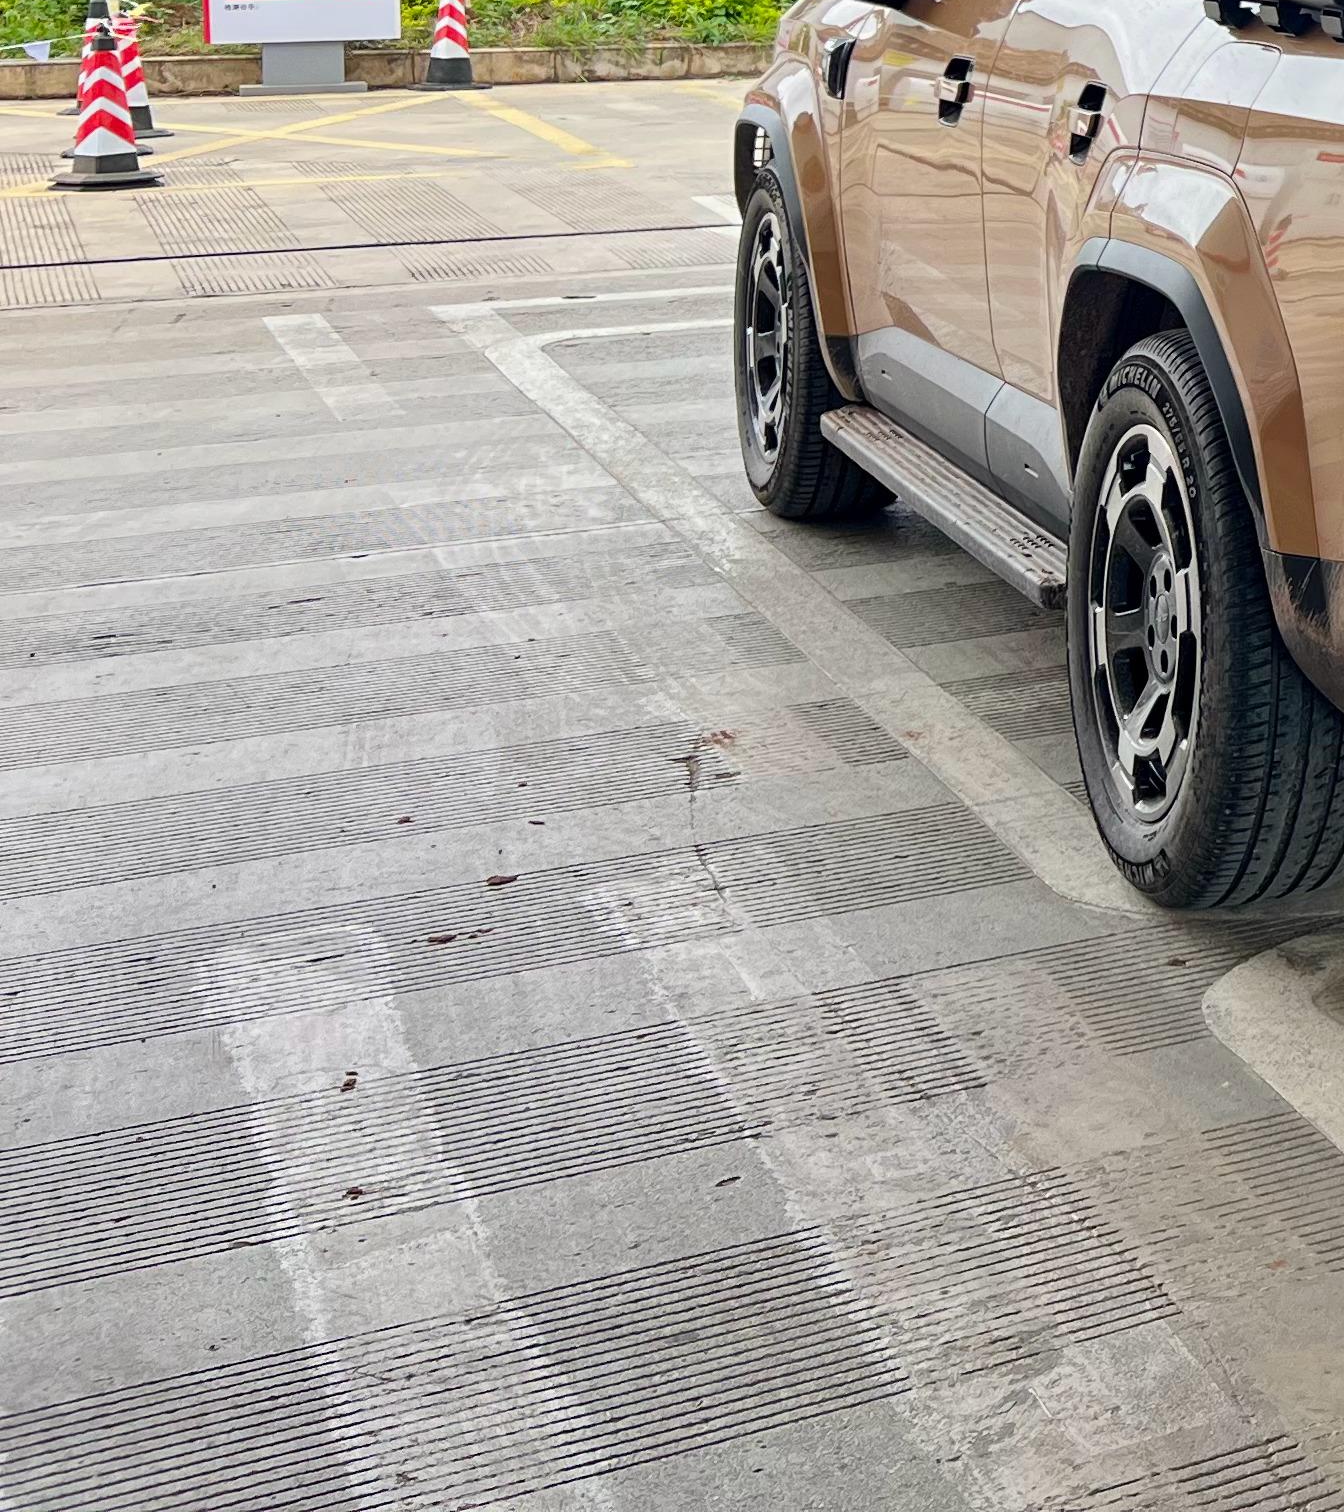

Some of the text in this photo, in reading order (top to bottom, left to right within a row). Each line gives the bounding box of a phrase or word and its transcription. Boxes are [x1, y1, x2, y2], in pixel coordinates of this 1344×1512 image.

[1108, 365, 1162, 400] MICHELIN
[1182, 456, 1191, 469] R
[1186, 475, 1197, 498] 20
